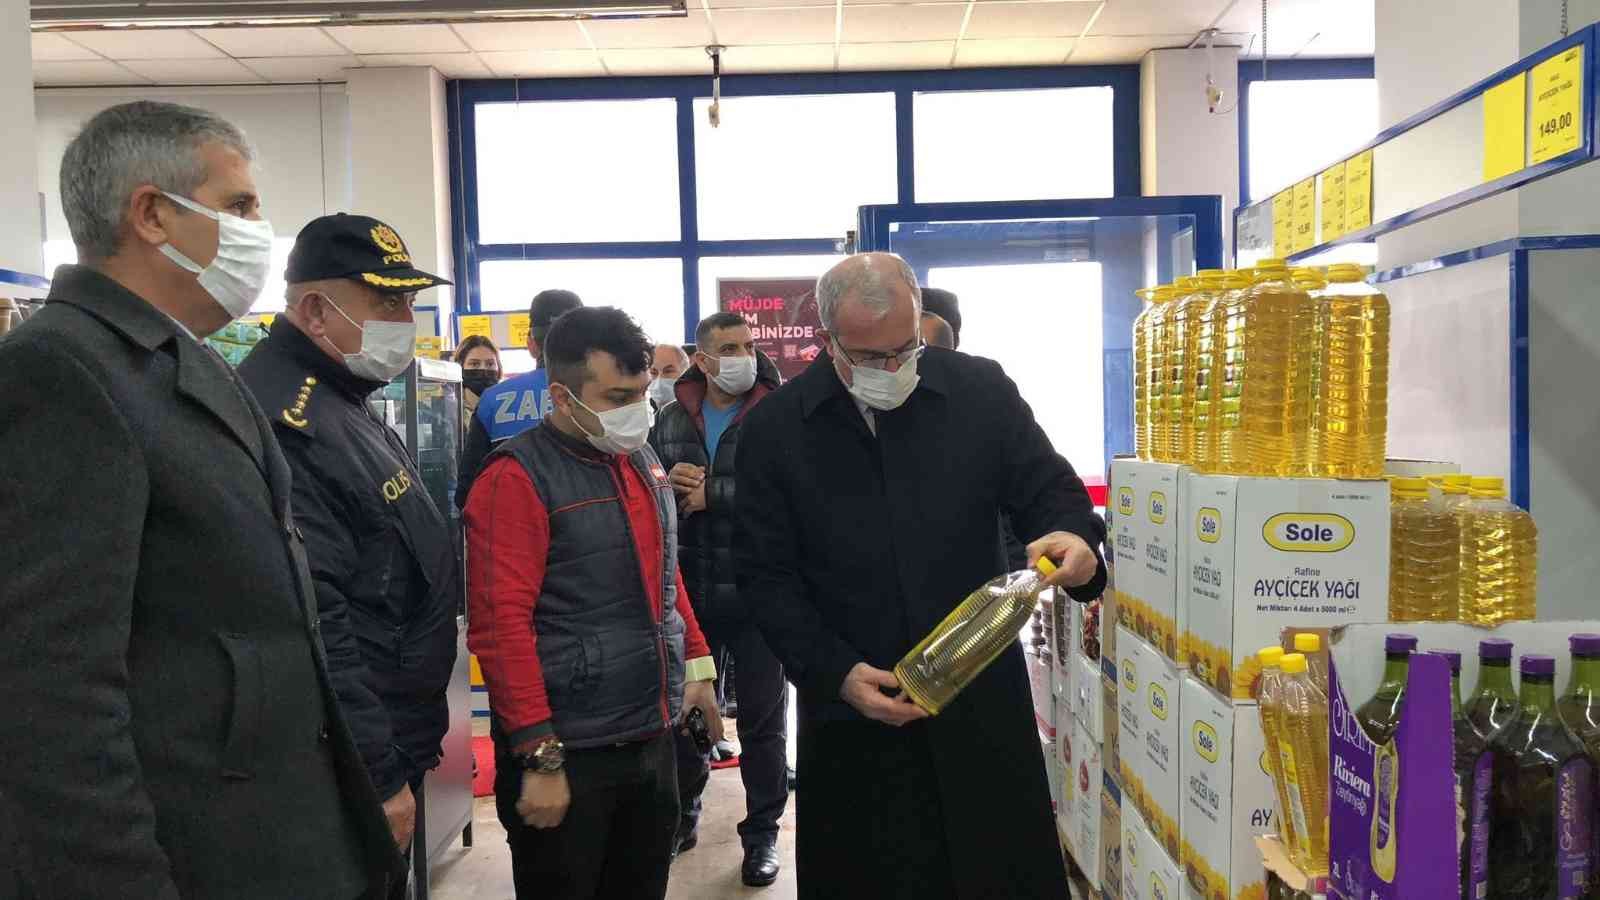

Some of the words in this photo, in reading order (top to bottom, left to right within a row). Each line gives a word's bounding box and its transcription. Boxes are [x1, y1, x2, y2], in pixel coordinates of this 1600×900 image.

[1539, 111, 1572, 138] 149,00
[729, 295, 784, 311] MÜJDE
[1201, 516, 1216, 534] Sole
[1286, 523, 1333, 541] Sole
[1294, 567, 1321, 577] Rafine
[1254, 576, 1319, 600] AYÇİÇEK
[1325, 578, 1360, 599] YAĞI
[1199, 730, 1213, 752] Sole
[1333, 754, 1371, 798] Riviera
[1251, 807, 1273, 827] AY
